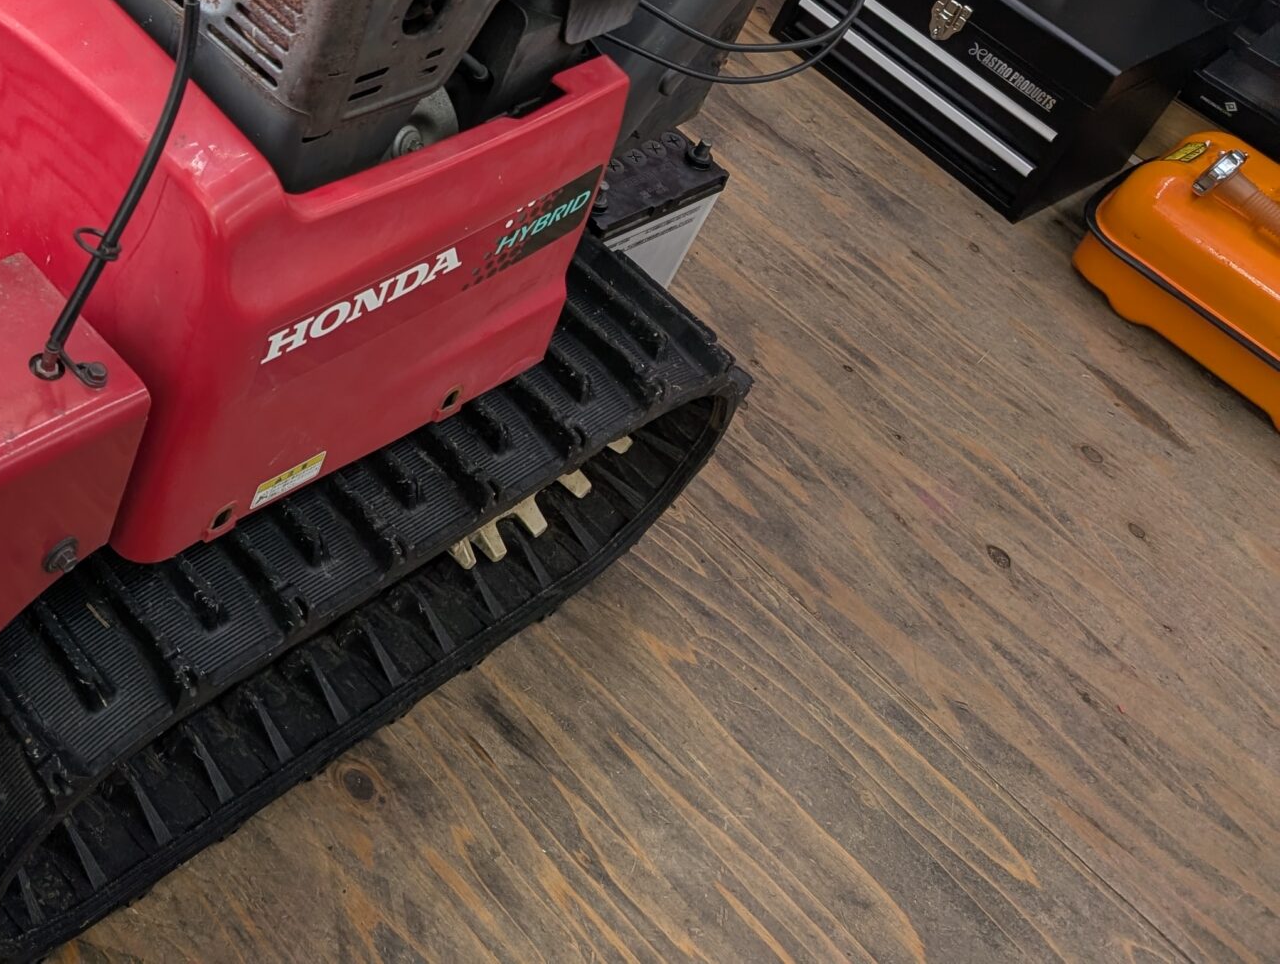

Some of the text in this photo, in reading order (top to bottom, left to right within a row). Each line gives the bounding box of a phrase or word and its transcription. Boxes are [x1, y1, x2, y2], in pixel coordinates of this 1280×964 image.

[982, 53, 1057, 110] ASTRO PRODUCTS
[494, 189, 592, 256] HYBRID
[260, 246, 462, 365] HONDA
